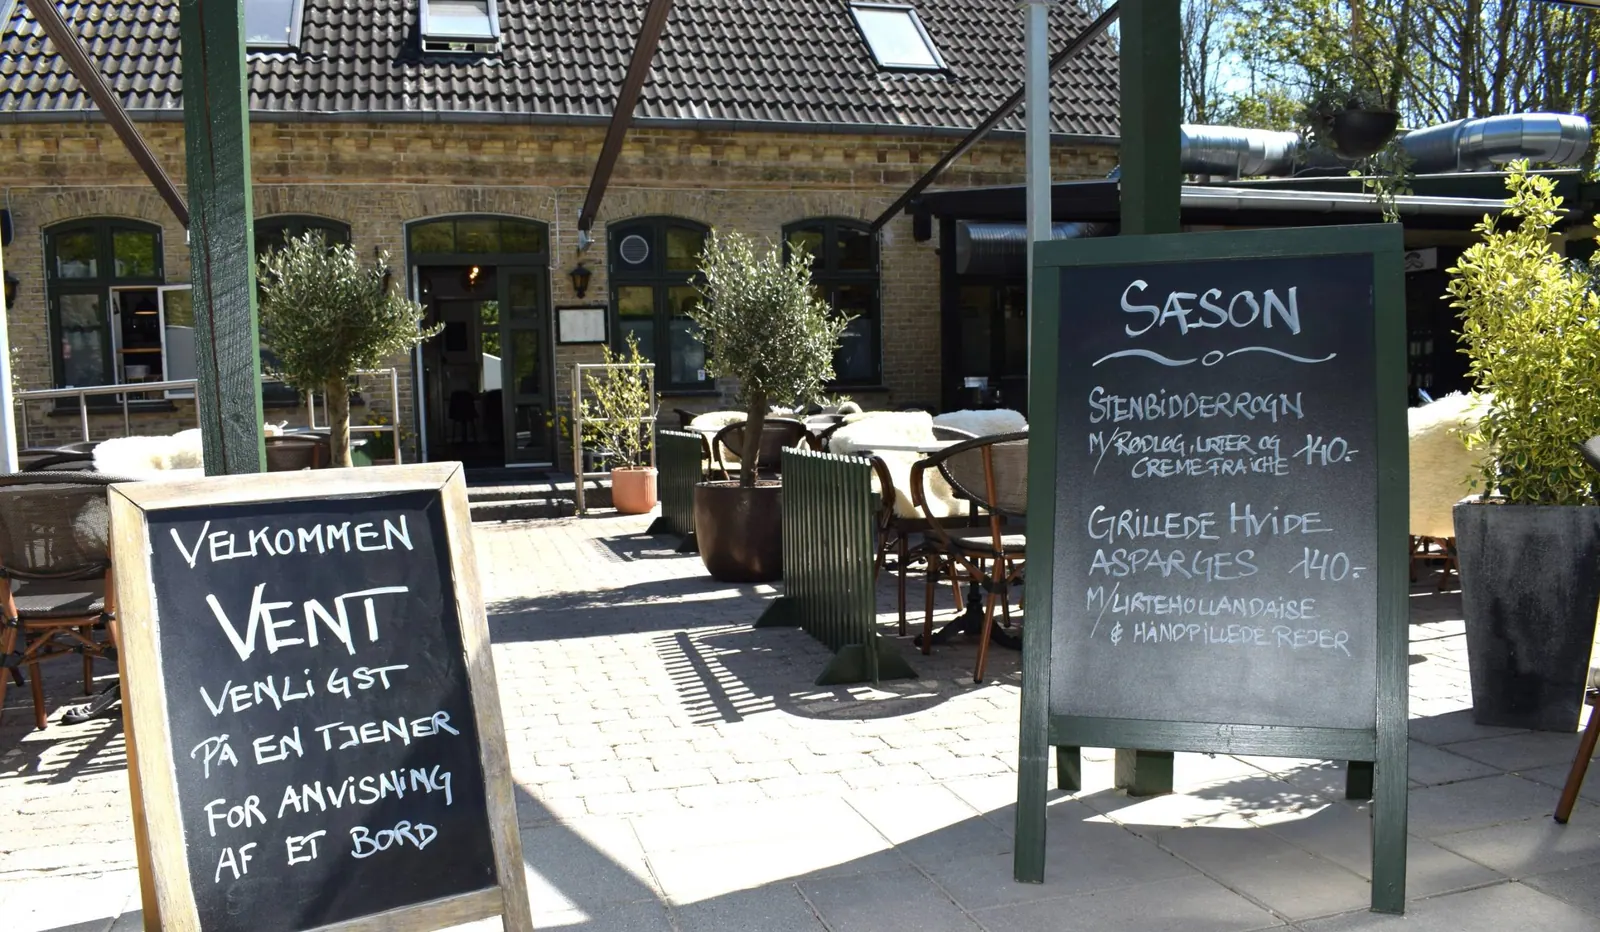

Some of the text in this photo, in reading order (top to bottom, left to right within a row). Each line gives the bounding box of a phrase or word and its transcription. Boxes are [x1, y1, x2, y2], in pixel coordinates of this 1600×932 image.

[1121, 279, 1301, 337] SÆSON
[1258, 434, 1281, 461] OG
[170, 515, 414, 568] VELKOMMEN
[1088, 549, 1259, 582] ASPARGES
[206, 583, 409, 661] VENT
[191, 711, 460, 779] PÅ EN TJENER
[204, 799, 267, 836] FOR
[215, 821, 438, 883] AF ET BORD
